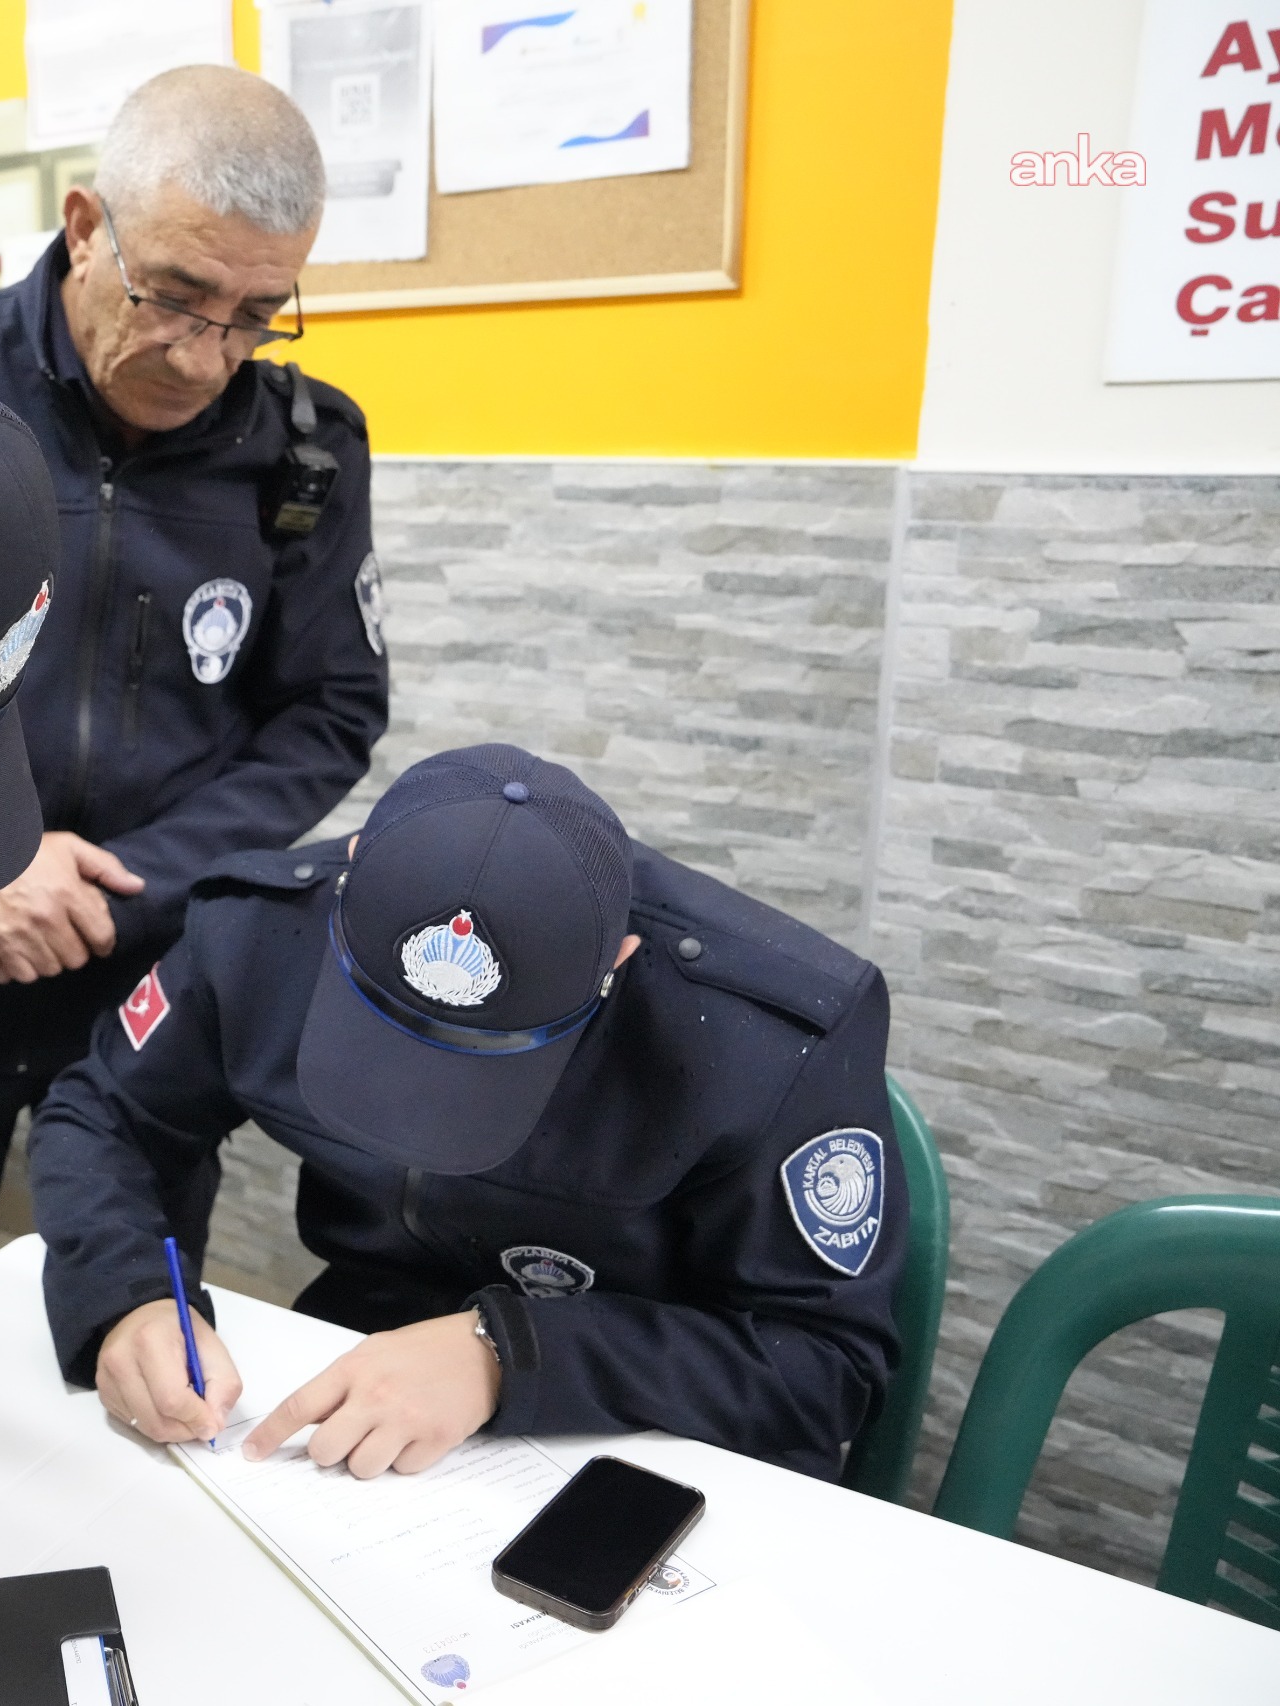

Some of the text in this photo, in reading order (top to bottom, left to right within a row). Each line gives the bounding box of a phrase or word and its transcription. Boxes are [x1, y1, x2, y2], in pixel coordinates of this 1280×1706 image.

[1195, 102, 1280, 161] M
[1176, 274, 1280, 337] Ça
[802, 1147, 829, 1188] KARTAL
[813, 1215, 878, 1249] ZABITA
